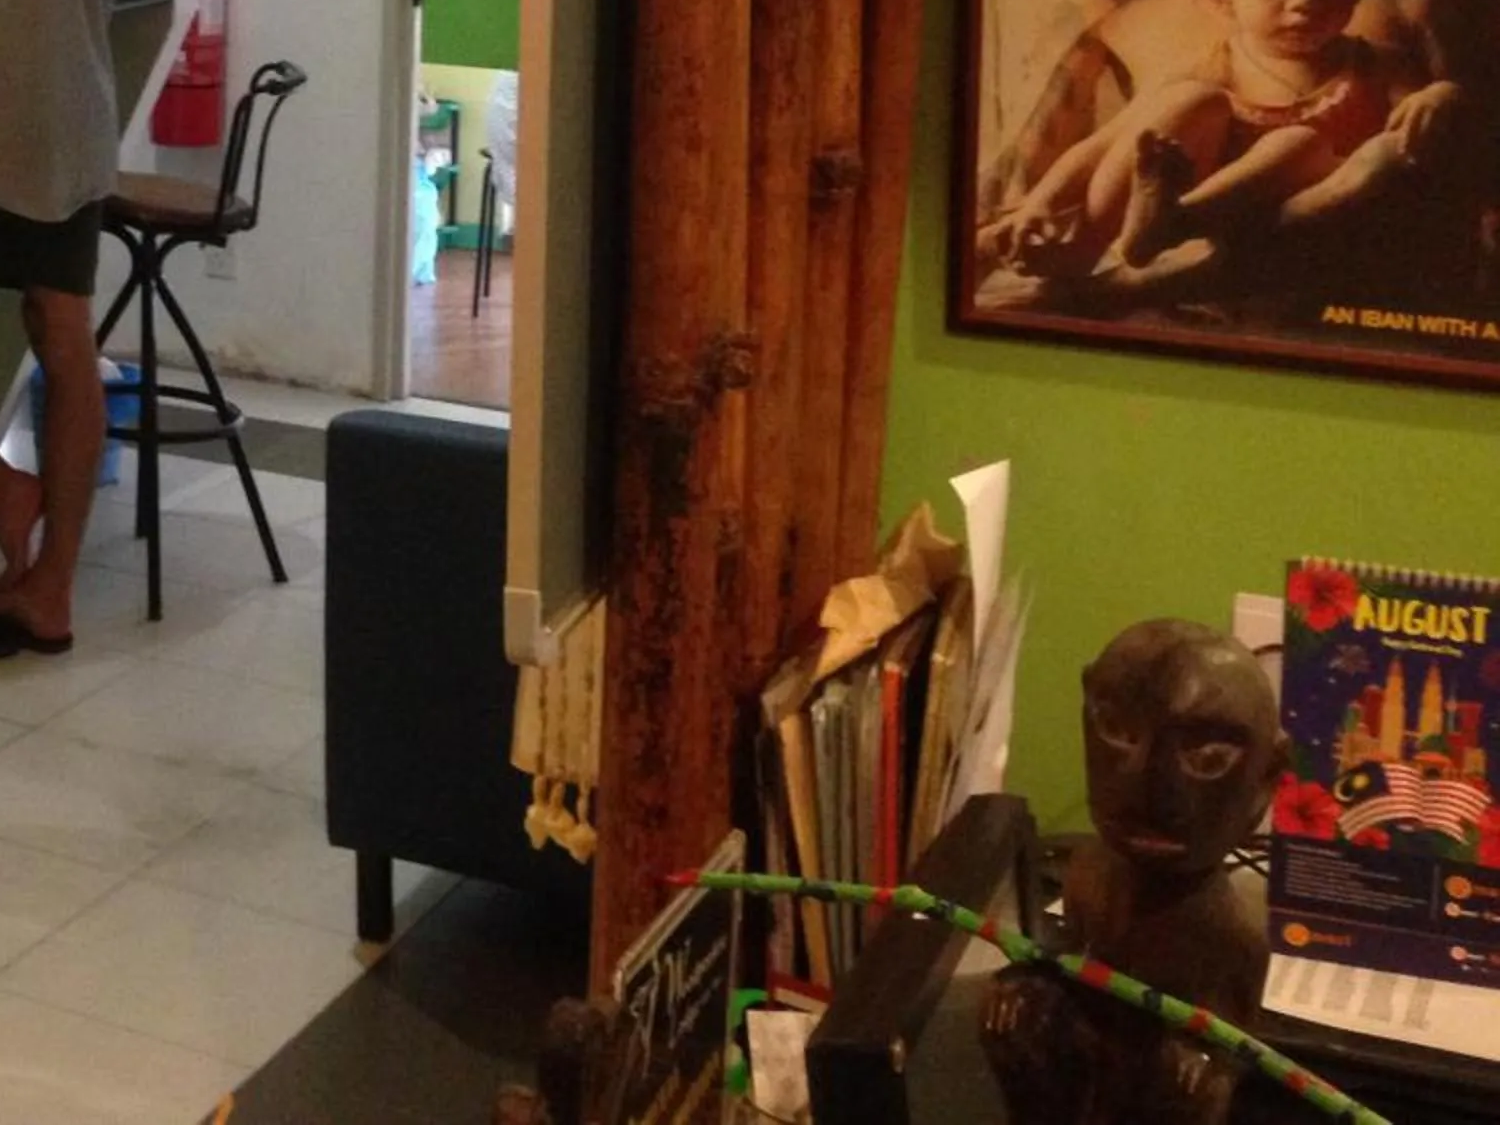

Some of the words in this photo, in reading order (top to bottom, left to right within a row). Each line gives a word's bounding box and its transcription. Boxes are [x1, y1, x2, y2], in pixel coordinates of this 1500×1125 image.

[1321, 305, 1355, 324] AN
[1360, 309, 1414, 331] IBAN
[1417, 315, 1476, 339] WITH
[1482, 322, 1500, 341] A
[1353, 592, 1493, 646] AUGUST
